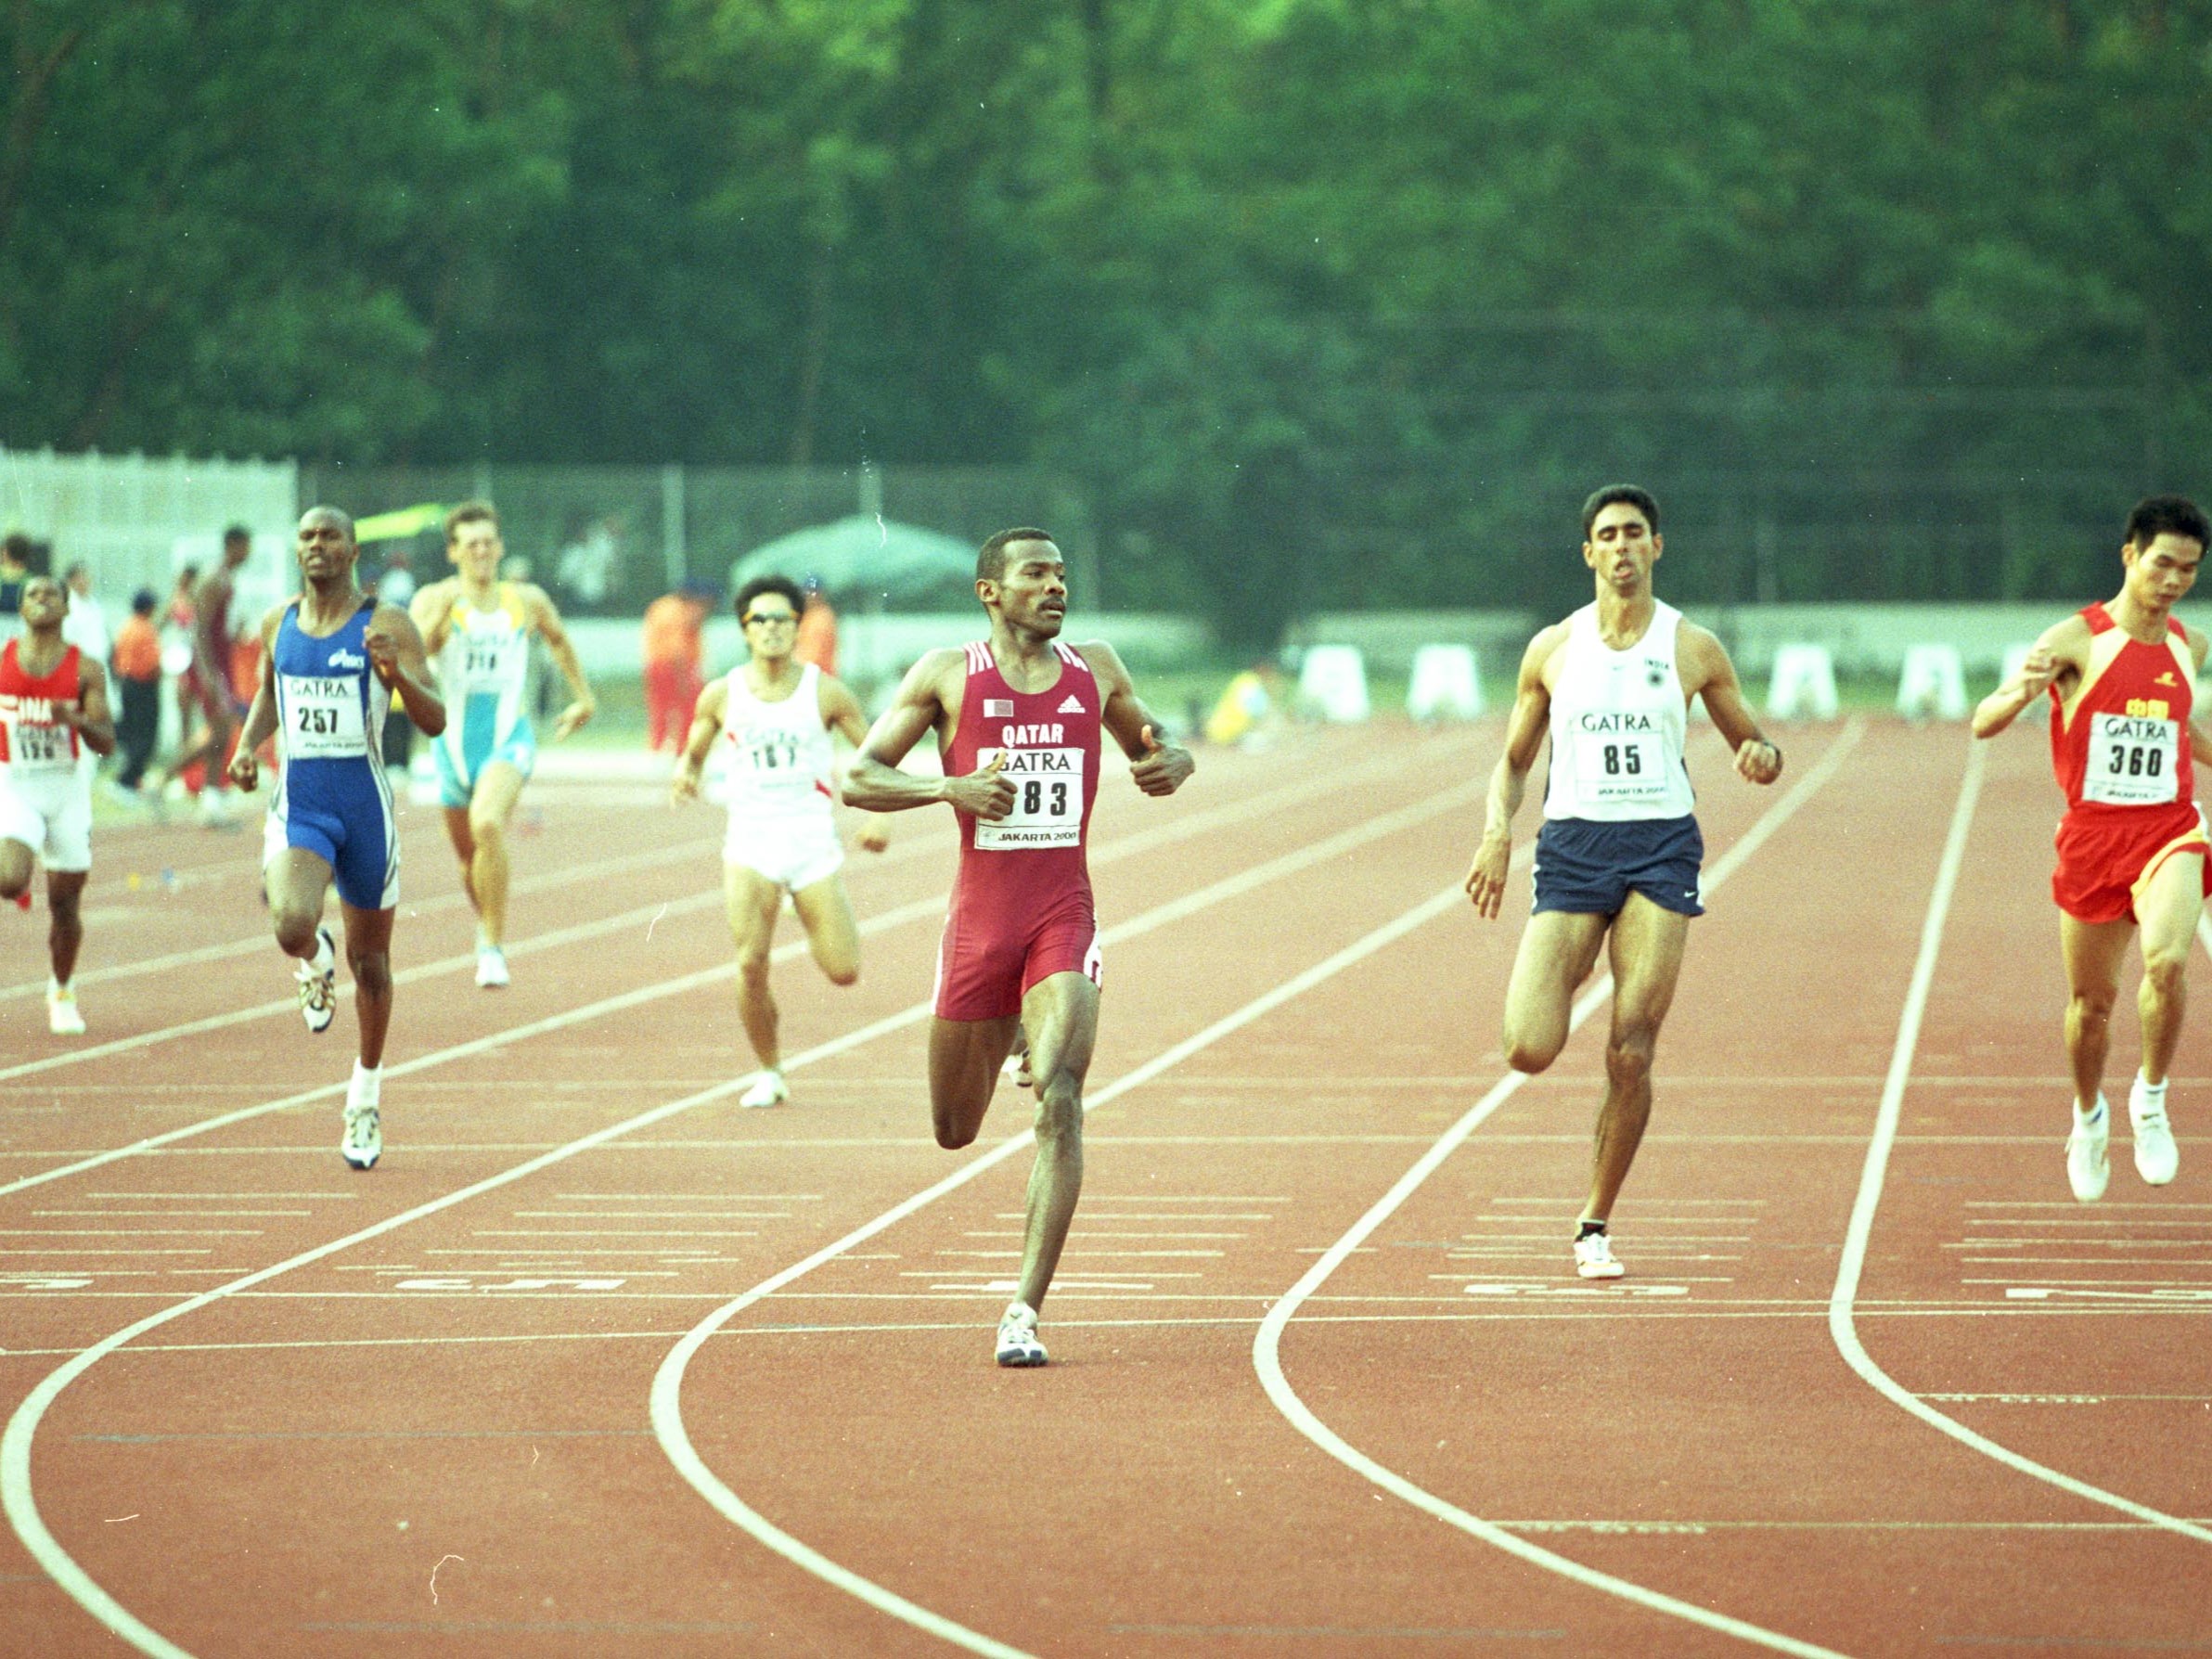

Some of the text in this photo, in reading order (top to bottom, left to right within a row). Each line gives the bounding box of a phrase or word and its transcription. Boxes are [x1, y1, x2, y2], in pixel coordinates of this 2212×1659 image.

[1644, 658, 1669, 670] INDIA
[290, 680, 348, 698] GATRA
[298, 707, 338, 733] 257
[1582, 714, 1651, 732] GATRA
[2105, 718, 2167, 740] GATRA
[1002, 724, 1064, 749] QATAR
[1604, 745, 1641, 776] 85
[2109, 745, 2163, 778] 360
[998, 831, 1076, 842] JAKARTA 2000
